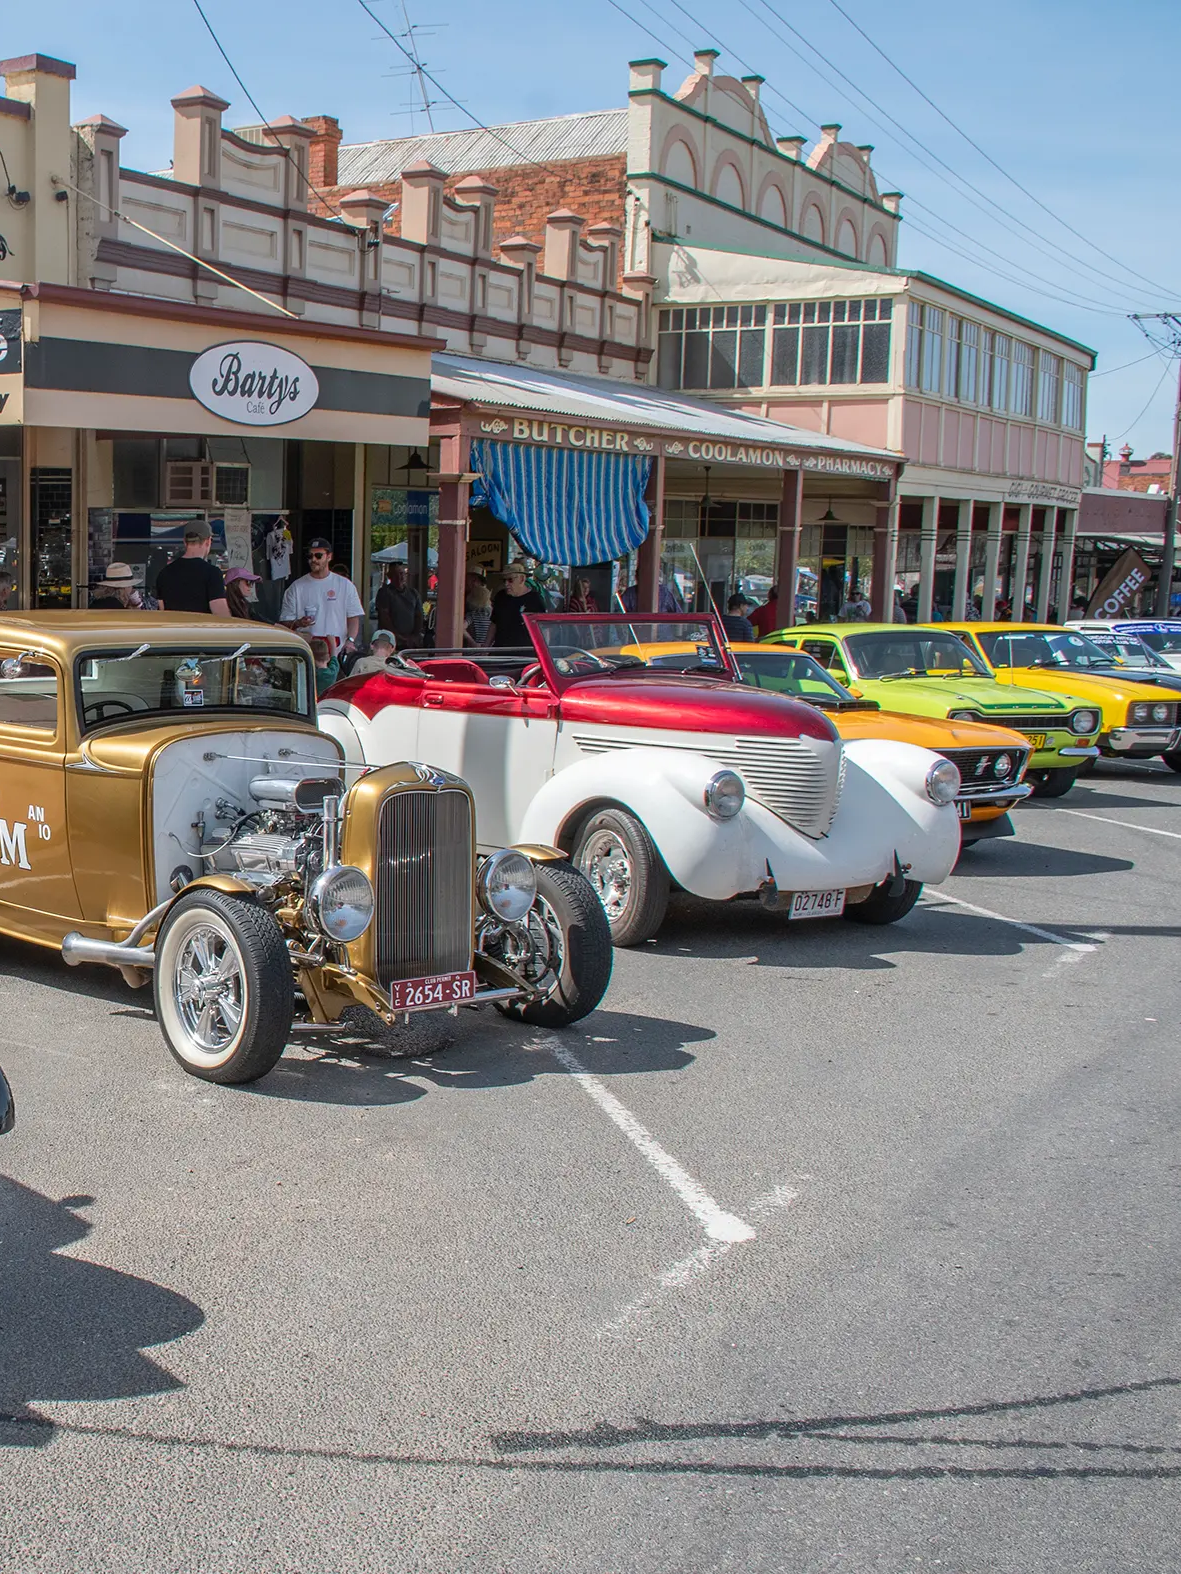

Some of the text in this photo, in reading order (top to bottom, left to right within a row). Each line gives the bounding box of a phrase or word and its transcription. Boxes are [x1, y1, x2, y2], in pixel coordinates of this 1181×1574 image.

[212, 351, 300, 415] Bartys
[246, 401, 265, 414] Café
[512, 418, 630, 452] BUTCHER
[688, 441, 784, 467] COOLAMON
[817, 456, 882, 476] PHARMACY
[1094, 567, 1146, 620] COFFEE
[27, 804, 45, 822] AN
